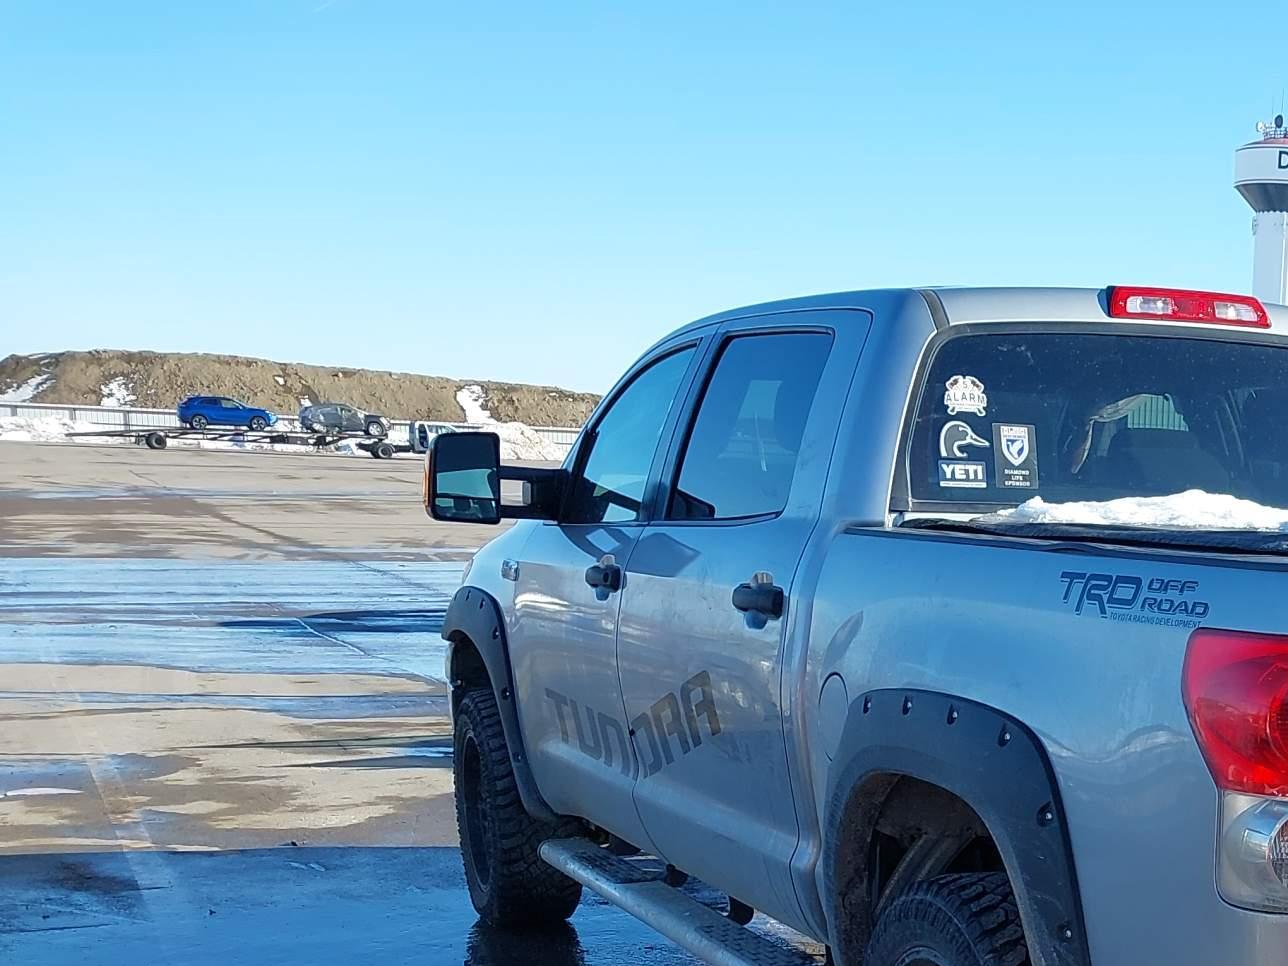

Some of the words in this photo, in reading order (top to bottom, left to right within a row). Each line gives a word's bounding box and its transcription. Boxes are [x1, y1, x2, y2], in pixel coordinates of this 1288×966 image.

[946, 391, 986, 405] ALARM
[941, 463, 983, 480] YETI
[1060, 570, 1143, 619] TRD
[1146, 577, 1200, 596] OFF
[1140, 596, 1211, 619] ROAD
[1109, 611, 1132, 623] TOYOTA
[1132, 614, 1155, 625] RACING
[1155, 616, 1202, 629] DEVELOPMENT
[544, 669, 722, 782] TUNDRA
